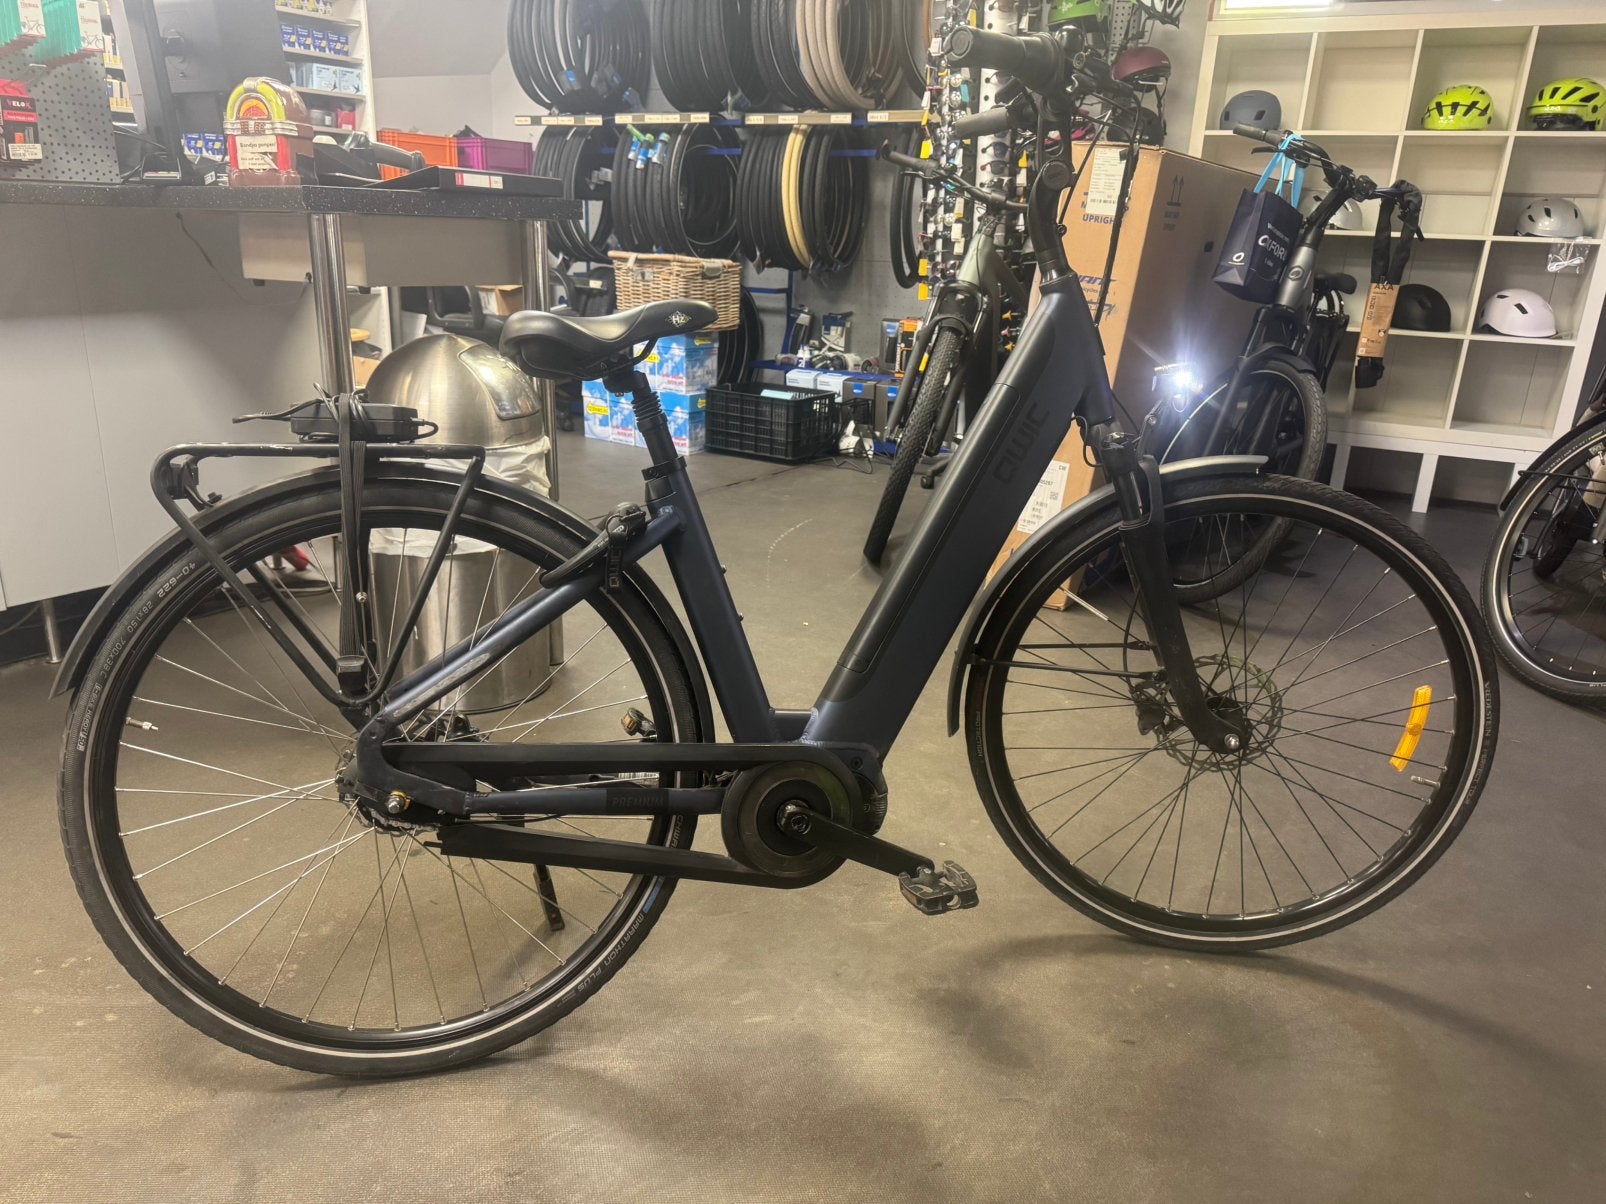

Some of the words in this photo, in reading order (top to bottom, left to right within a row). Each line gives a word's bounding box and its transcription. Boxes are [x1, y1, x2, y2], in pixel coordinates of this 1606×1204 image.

[1082, 214, 1115, 225] UPRIGH
[993, 401, 1050, 485] QWIC
[156, 562, 197, 598] 40-622
[611, 796, 664, 808] PREMIUM
[671, 814, 684, 848] CHWA
[603, 912, 645, 966] MARATHON
[577, 966, 603, 992] PLUS
